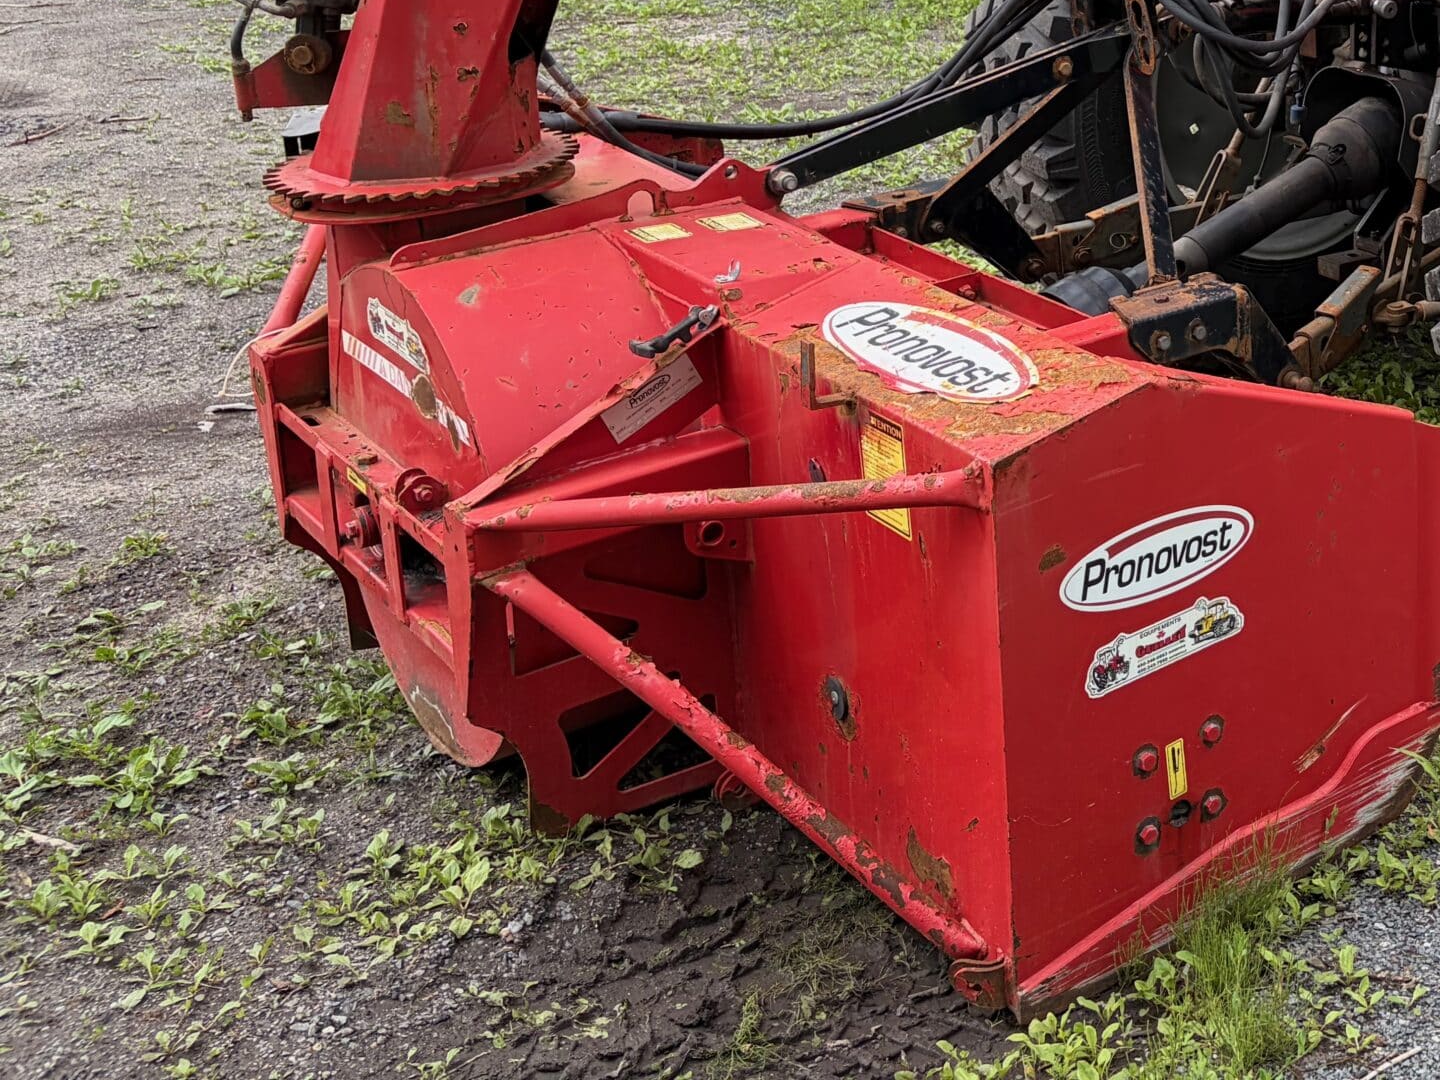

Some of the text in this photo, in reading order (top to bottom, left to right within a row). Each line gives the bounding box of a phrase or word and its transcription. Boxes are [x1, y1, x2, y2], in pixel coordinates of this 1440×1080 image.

[835, 306, 1013, 394] Pronovost
[629, 376, 668, 409] Pronovost
[1080, 520, 1233, 602] Pronovost
